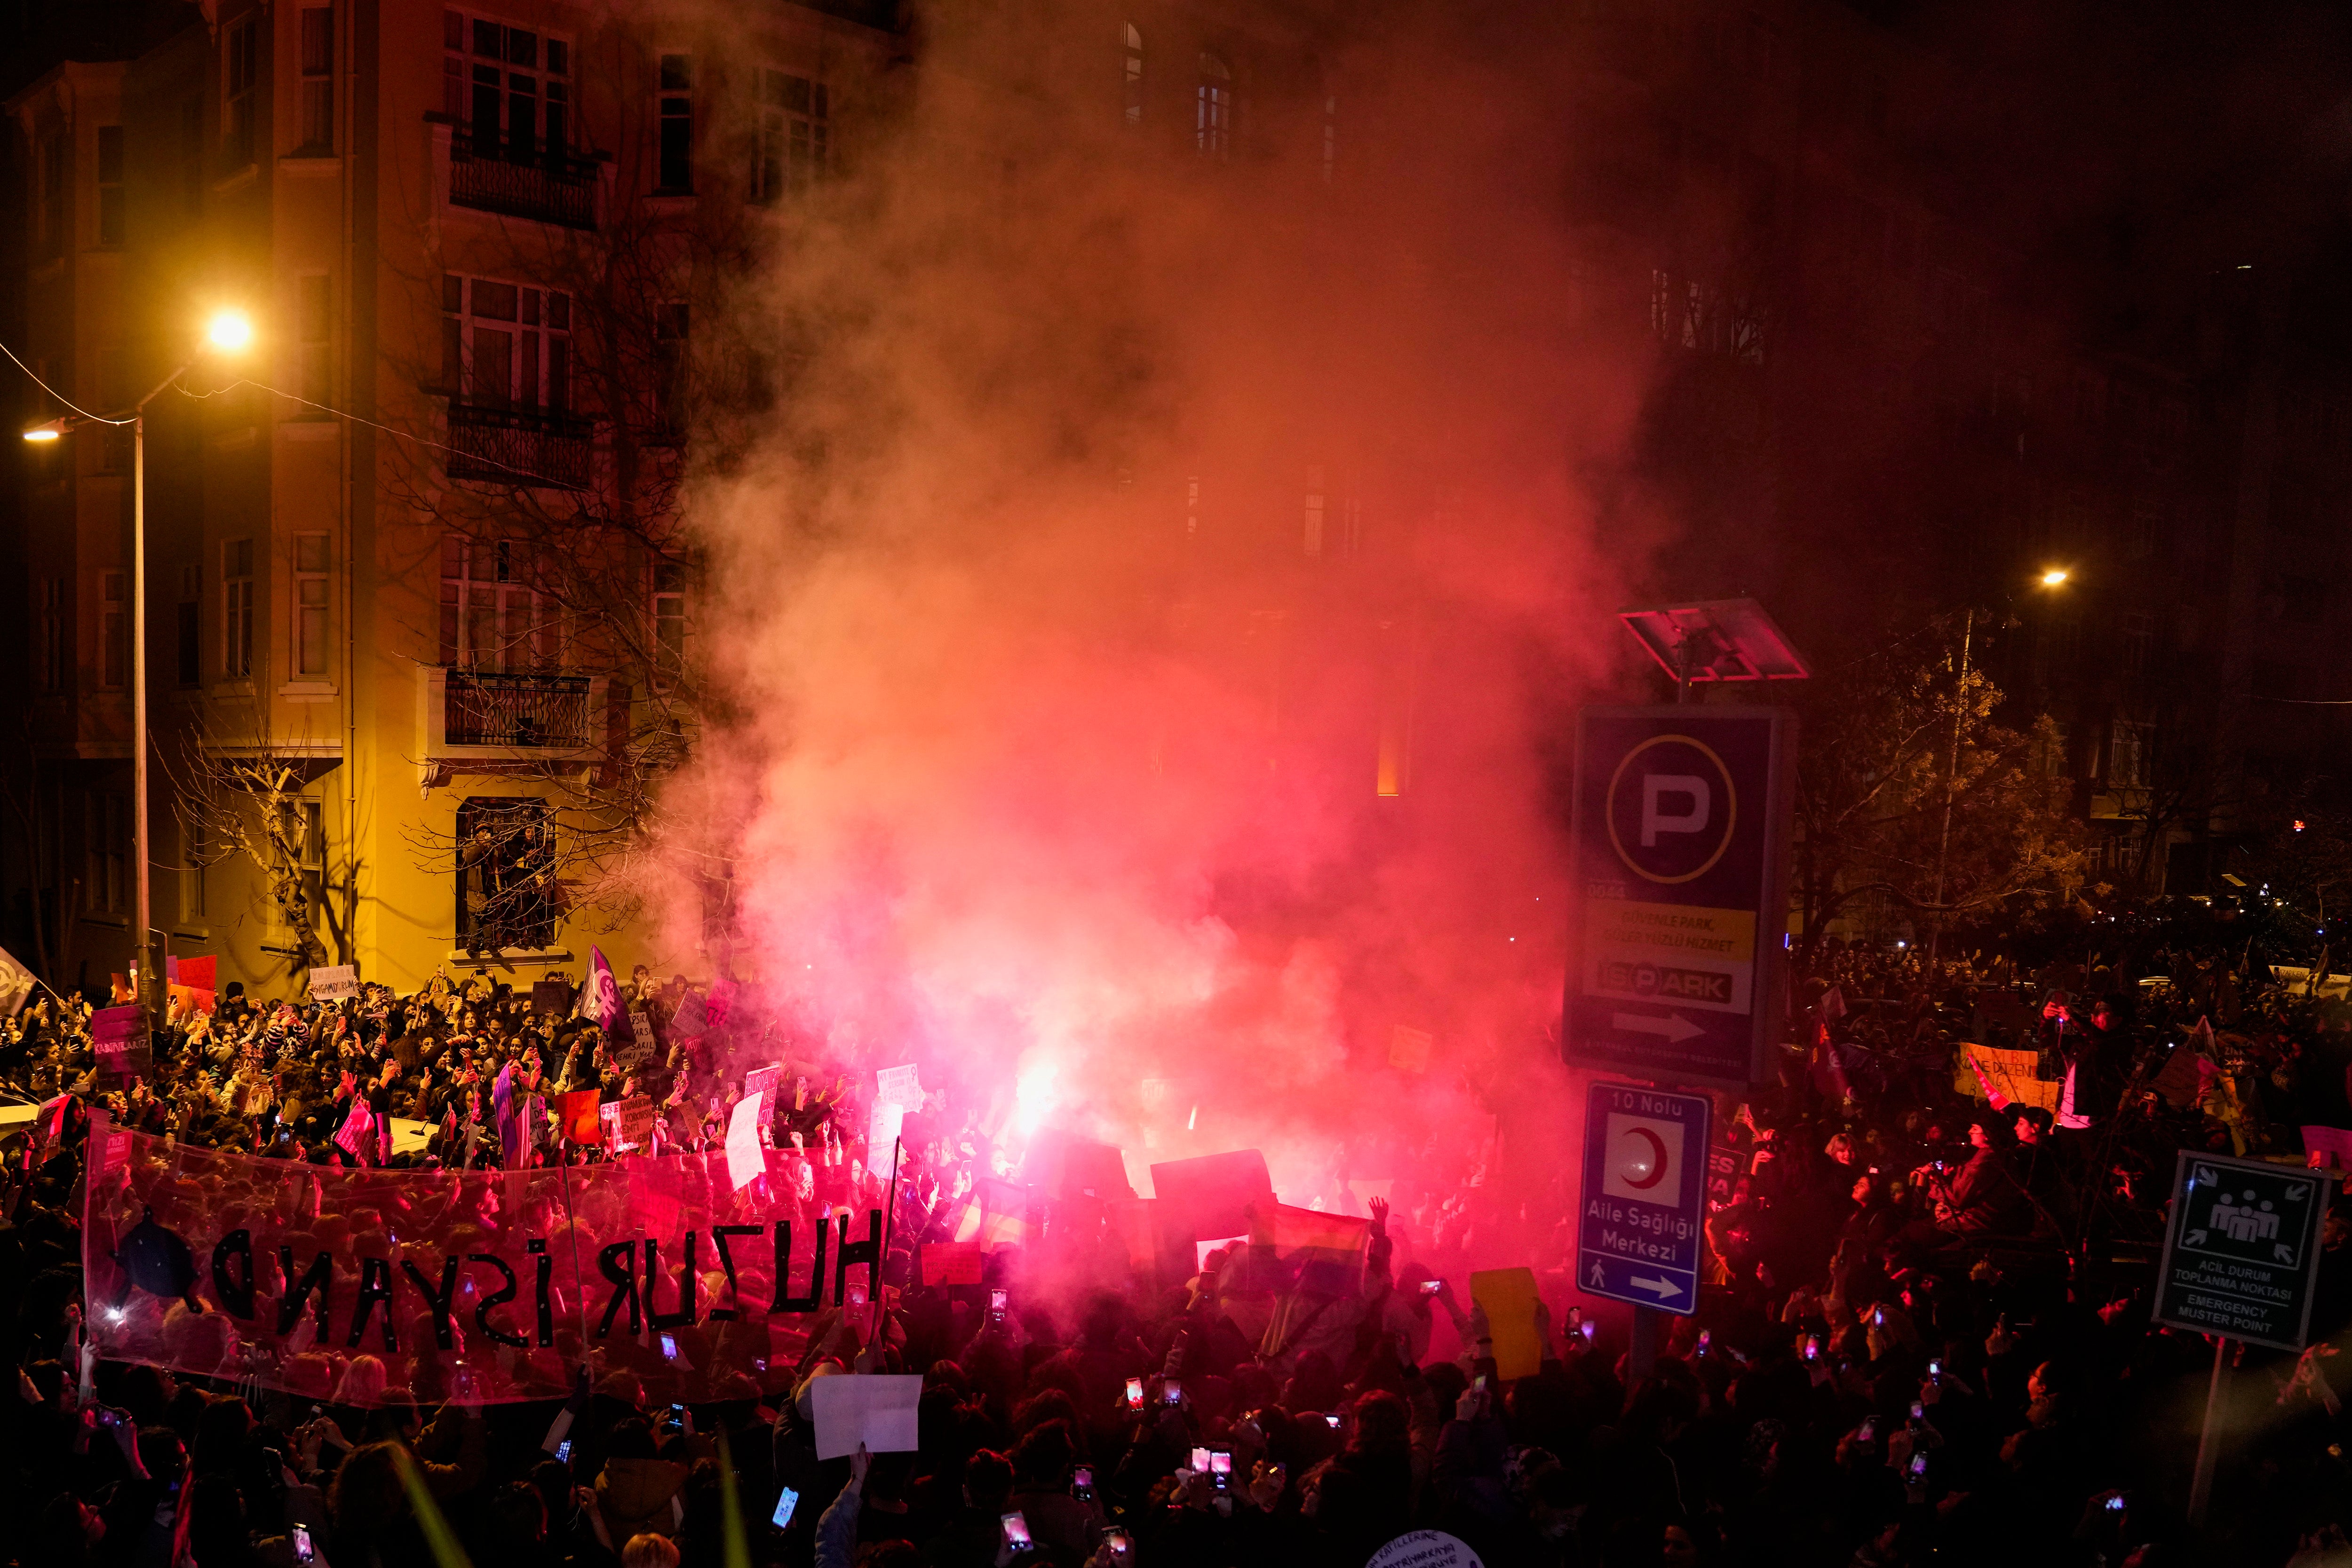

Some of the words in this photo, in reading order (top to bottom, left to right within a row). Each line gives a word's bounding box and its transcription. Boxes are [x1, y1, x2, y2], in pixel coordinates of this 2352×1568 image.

[1641, 774, 1711, 847] P
[1613, 1092, 1634, 1109] 10
[1641, 1096, 1682, 1117] Nolu
[337, 1118, 353, 1141] SORULACAK
[1588, 1200, 1622, 1222] Aile
[1628, 1207, 1695, 1240] Sağlığı
[1602, 1229, 1677, 1262] Merkezi
[2175, 1268, 2237, 1290] TOPLANMA
[2240, 1281, 2292, 1300] NOKTASI
[2199, 1259, 2225, 1274] ACİL
[2228, 1265, 2271, 1283] DURUM
[2178, 1305, 2229, 1325] MUSTER
[2233, 1315, 2272, 1332] POINT
[2187, 1294, 2268, 1317] EMERGENCY
